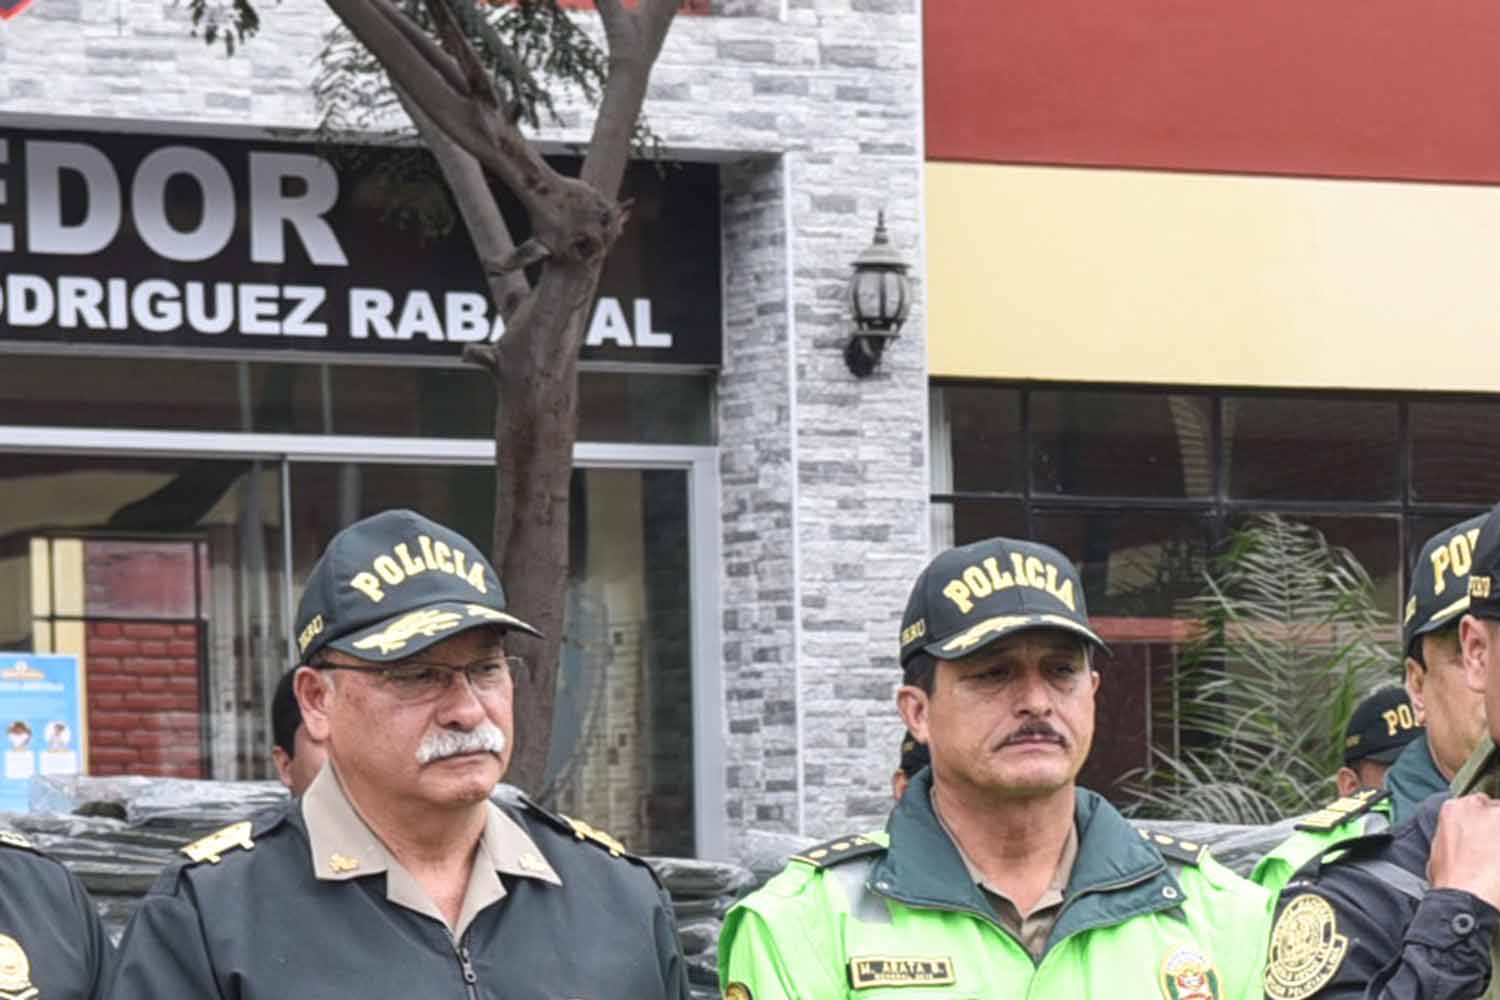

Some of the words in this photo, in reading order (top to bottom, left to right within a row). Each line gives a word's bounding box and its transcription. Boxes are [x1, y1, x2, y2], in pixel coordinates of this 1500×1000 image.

[0, 138, 349, 267] DOR
[0, 273, 328, 338] DRIGUEZ
[350, 286, 673, 348] RABAL
[350, 535, 488, 603] POLICIA
[942, 551, 1077, 615] POLICIA
[1381, 703, 1420, 737] PO
